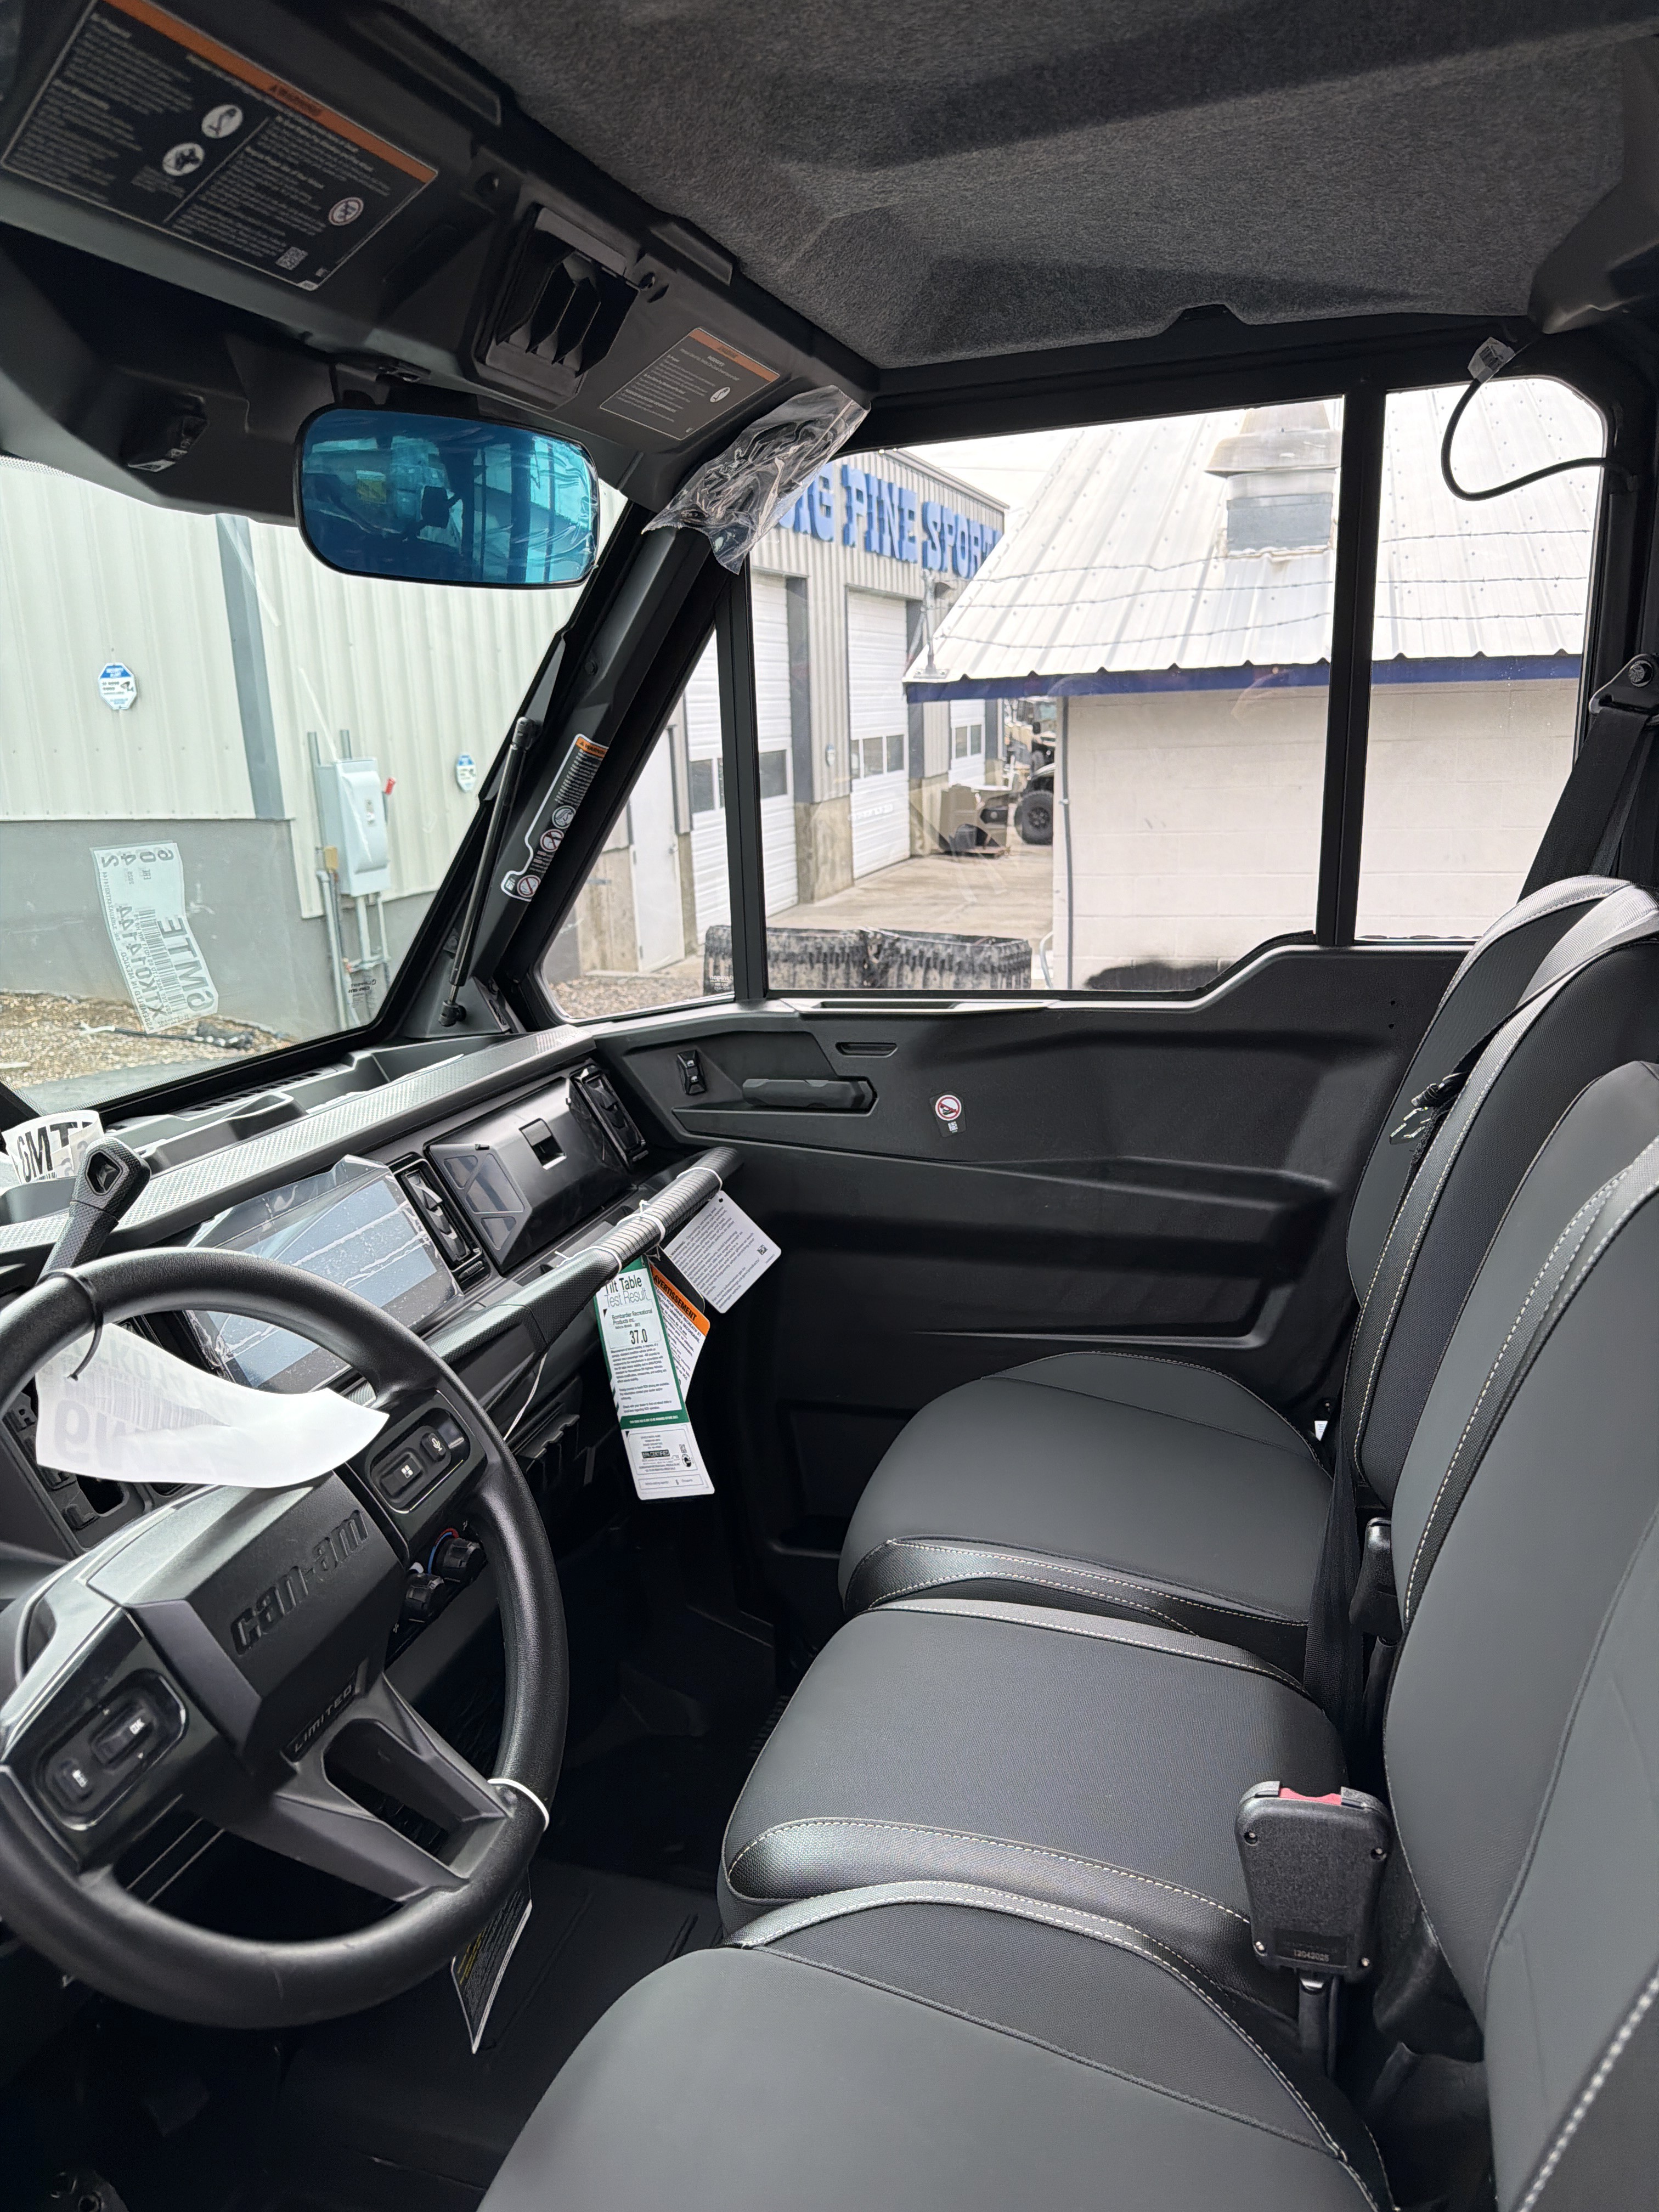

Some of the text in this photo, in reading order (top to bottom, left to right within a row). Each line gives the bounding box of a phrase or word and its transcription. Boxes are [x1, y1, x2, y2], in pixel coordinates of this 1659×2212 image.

[842, 464, 918, 563] PINE
[922, 501, 1005, 579] SPORT
[17, 1121, 93, 1183] 6MT
[604, 1287, 648, 1307] Test Result
[619, 1274, 642, 1290] Table
[653, 1274, 697, 1322] AVERTISSEMENT
[629, 1328, 648, 1345] 37.0
[231, 1510, 370, 1657] can-am
[293, 1683, 354, 1753] LIMITED
